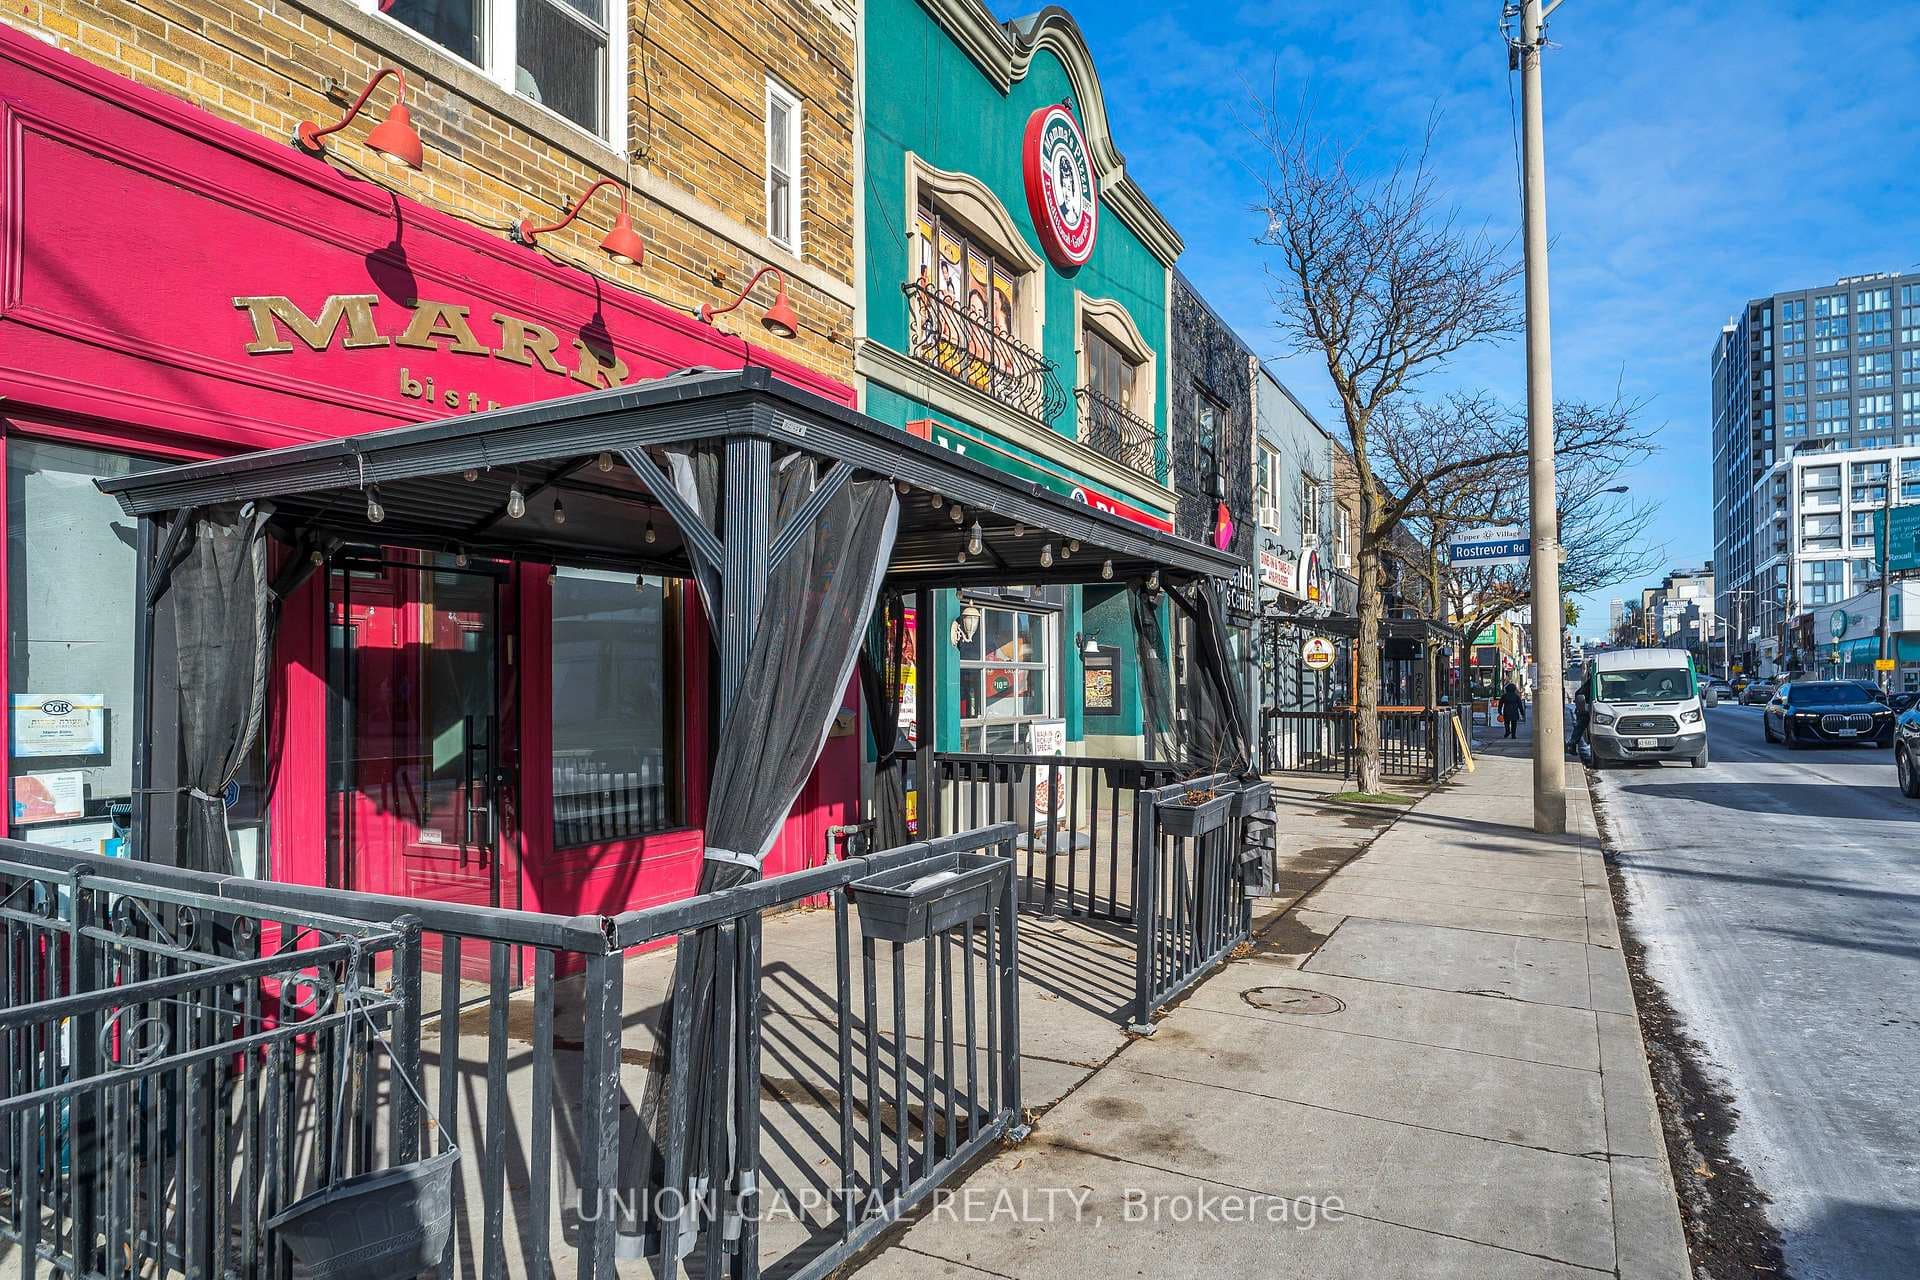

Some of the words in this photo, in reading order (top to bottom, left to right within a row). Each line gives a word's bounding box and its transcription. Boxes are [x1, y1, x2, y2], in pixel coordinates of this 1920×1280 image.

[232, 294, 640, 391] MARR
[400, 367, 502, 413] bistr
[1458, 534, 1480, 542] Upper
[1496, 530, 1521, 538] Village
[1456, 544, 1508, 558] Rostrevor
[1513, 543, 1525, 553] Rd
[1889, 552, 1912, 561] Rexall
[1229, 565, 1253, 592] alth
[1231, 588, 1254, 612] Centre
